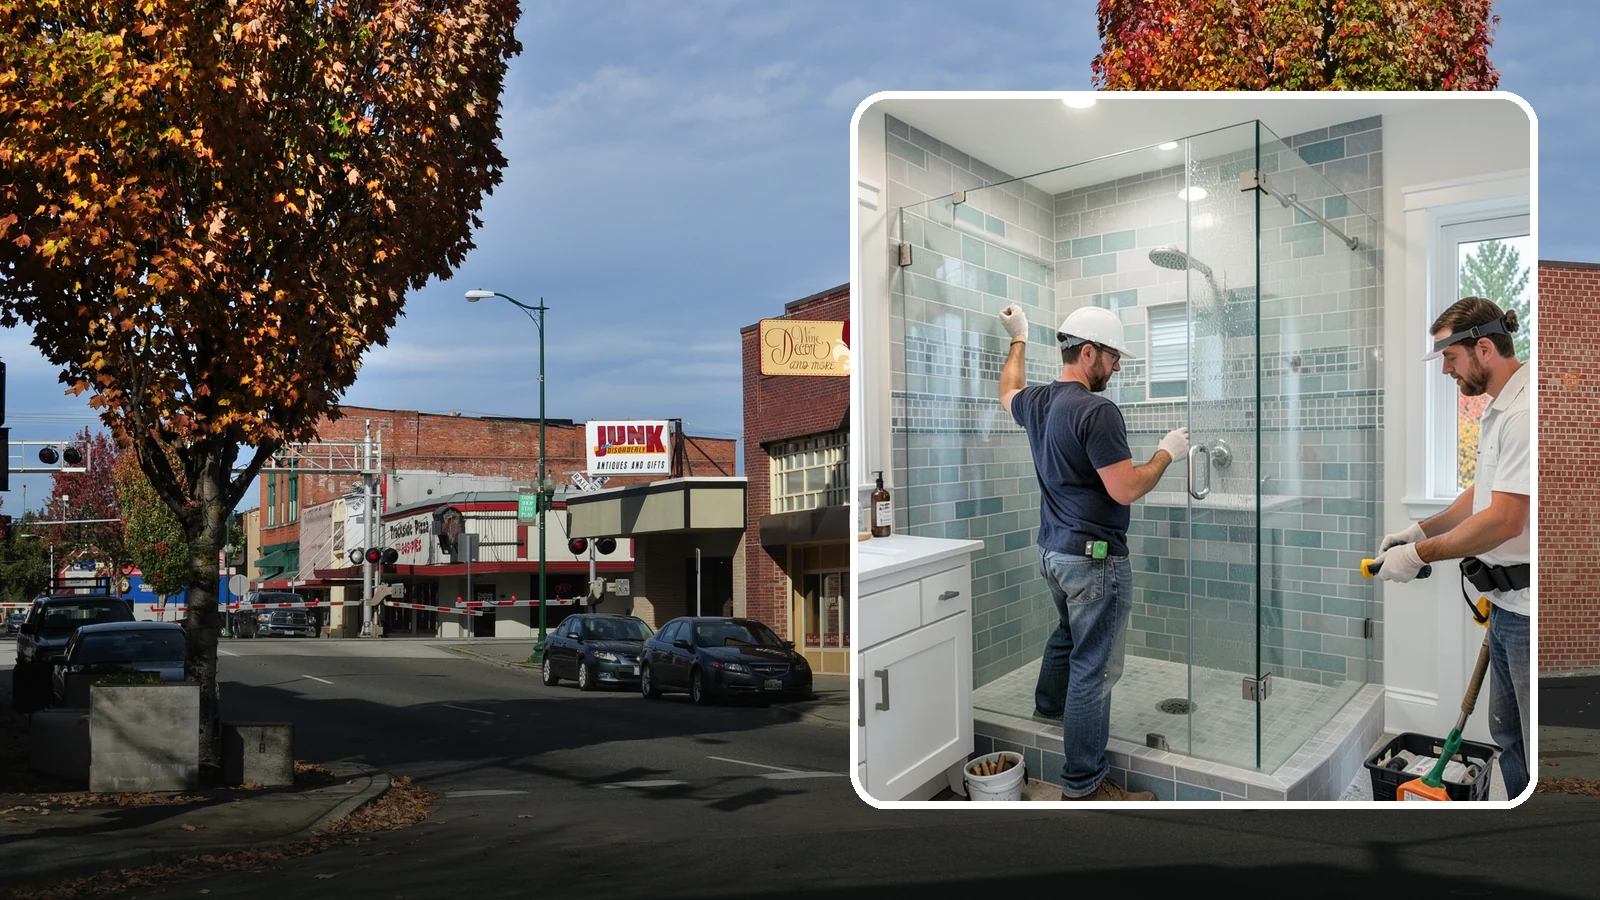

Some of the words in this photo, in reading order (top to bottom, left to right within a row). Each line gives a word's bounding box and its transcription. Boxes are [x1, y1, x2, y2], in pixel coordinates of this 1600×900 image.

[595, 425, 664, 457] JUNK
[597, 461, 628, 470] ANTIQUES
[631, 461, 643, 469] AND
[647, 460, 665, 469] GIFTS
[573, 473, 588, 490] RAIL
[414, 519, 429, 535] Pizza
